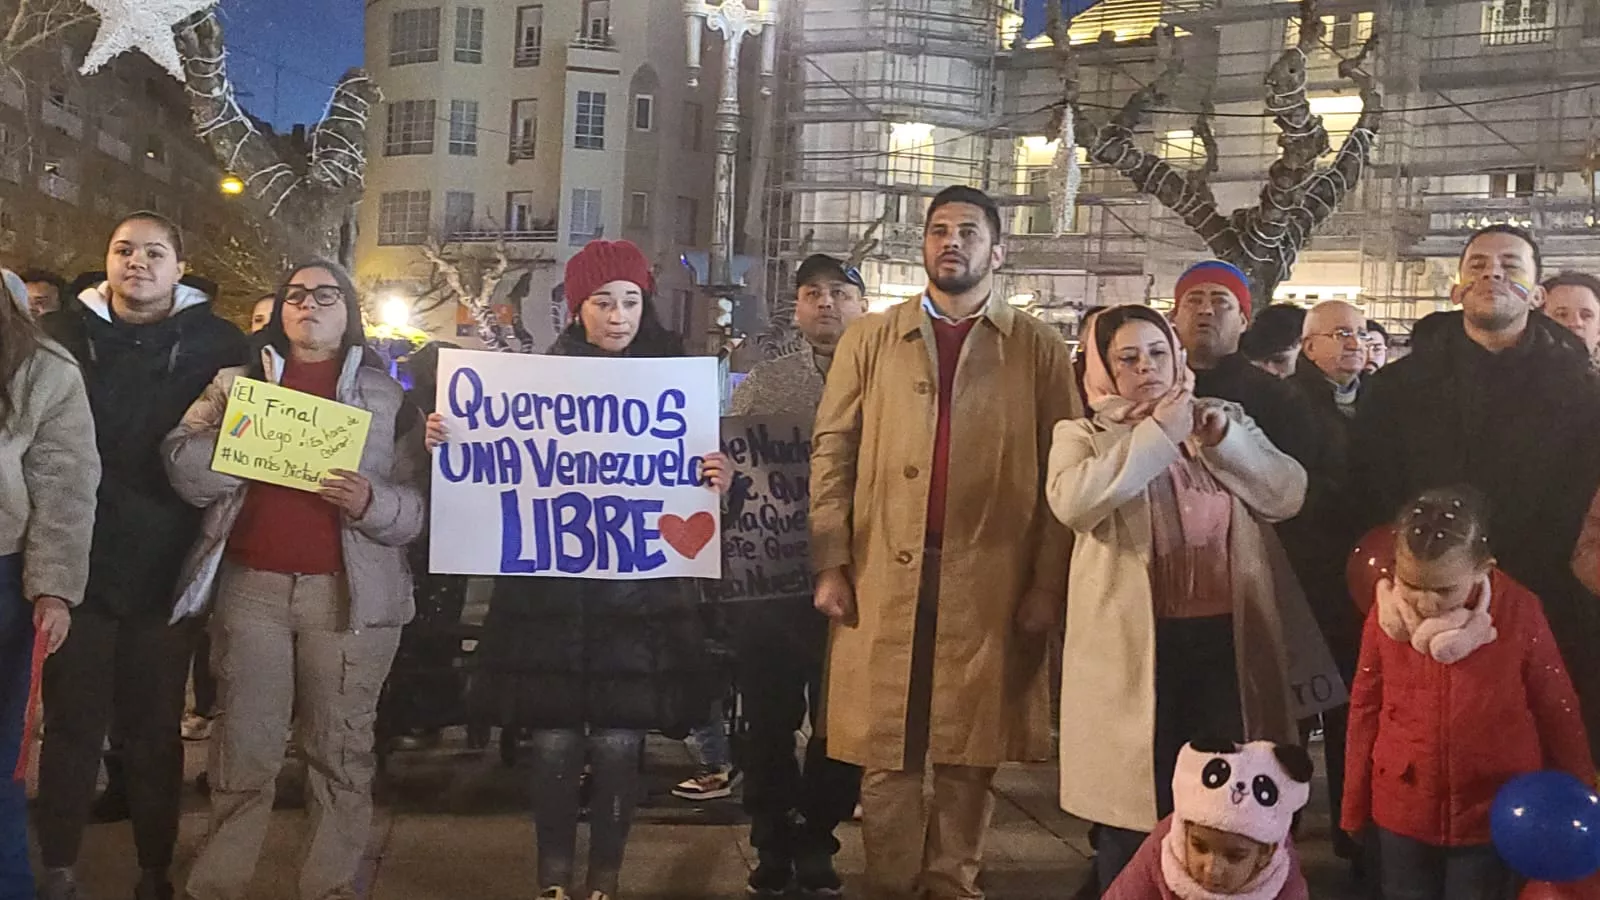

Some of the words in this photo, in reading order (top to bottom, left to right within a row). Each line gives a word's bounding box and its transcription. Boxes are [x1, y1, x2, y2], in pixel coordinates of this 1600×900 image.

[264, 398, 319, 428] Final
[254, 455, 281, 472] más
[439, 437, 522, 485] UNA
[500, 489, 667, 574] LIBRE
